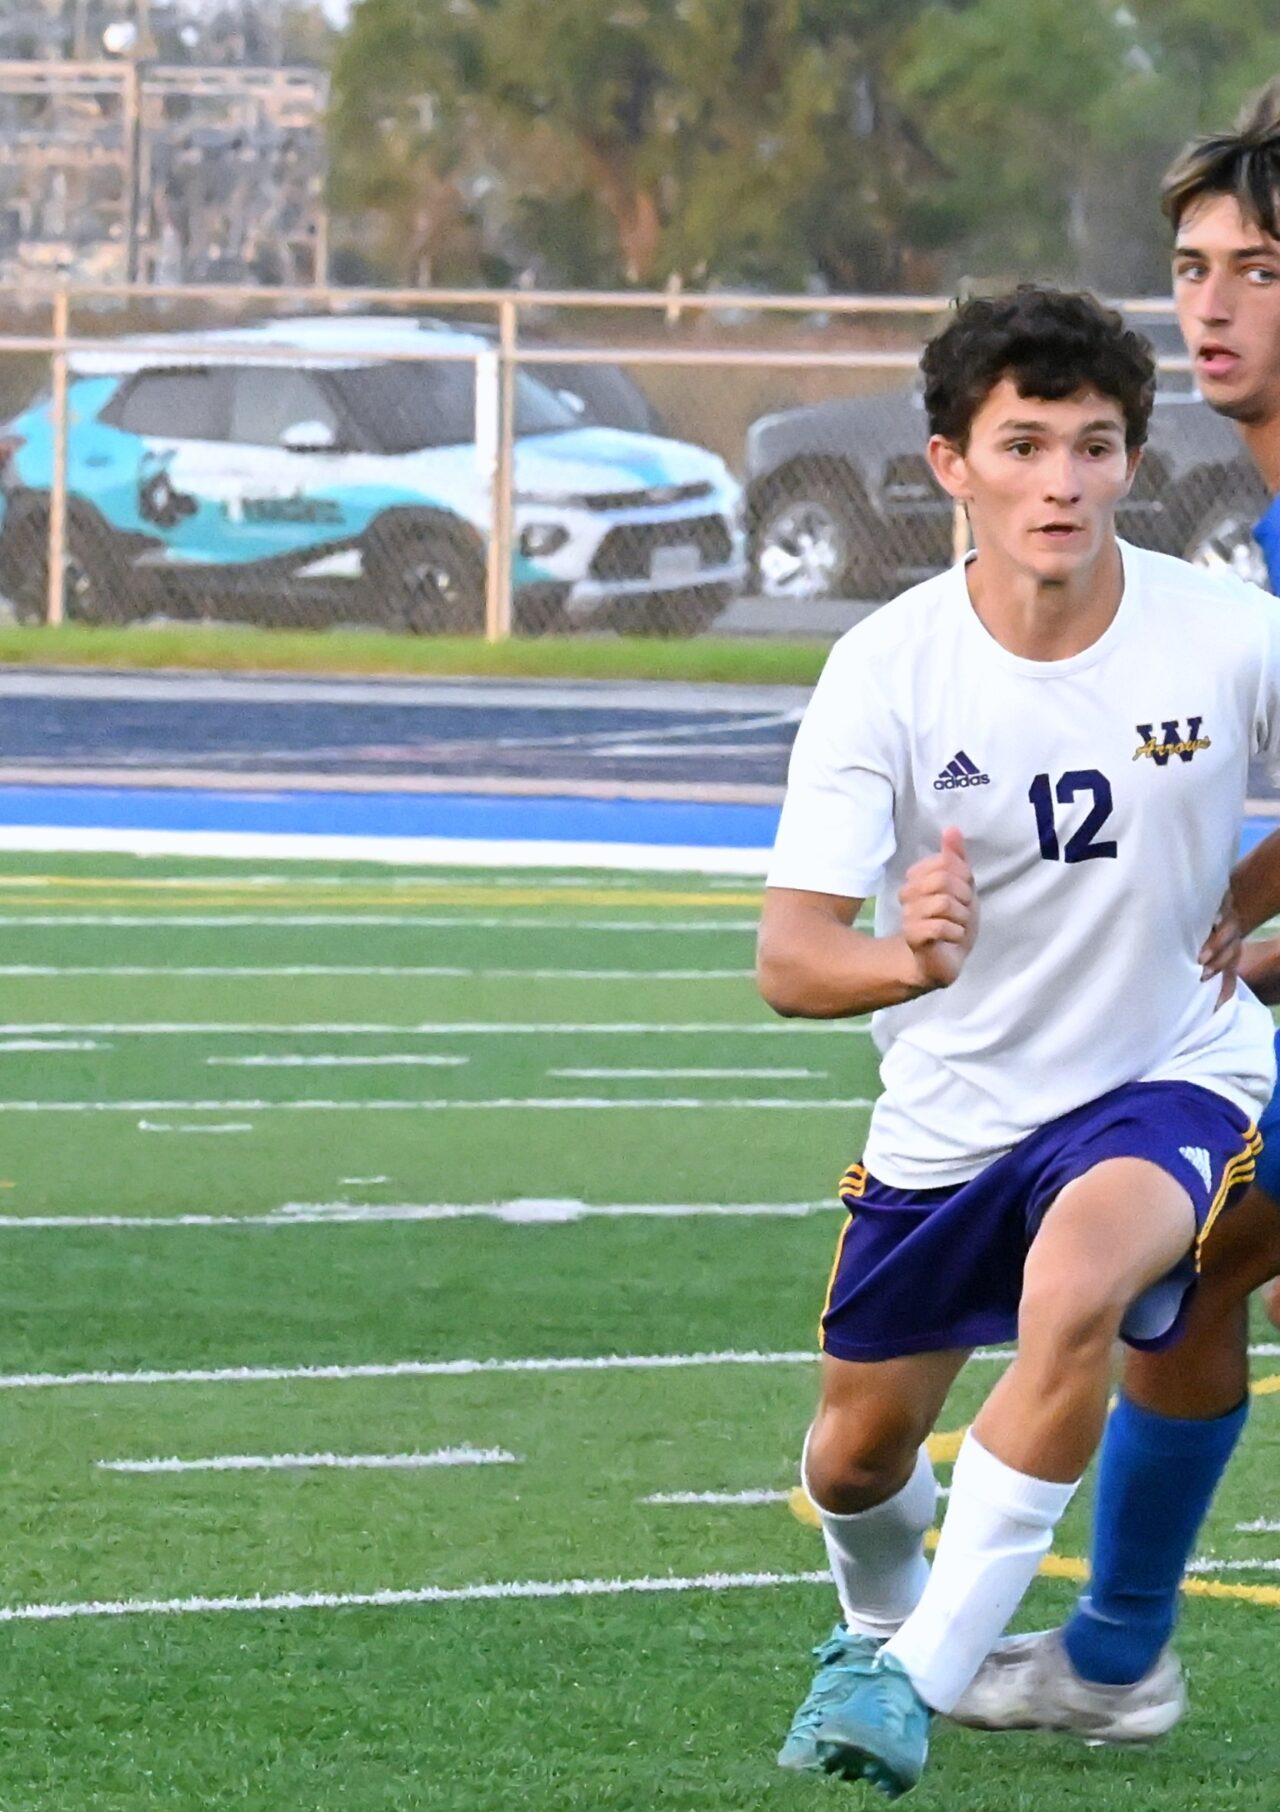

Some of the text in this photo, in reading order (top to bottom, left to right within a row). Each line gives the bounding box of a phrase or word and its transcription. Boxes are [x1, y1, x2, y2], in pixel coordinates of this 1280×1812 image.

[1136, 716, 1202, 766] W
[933, 773, 990, 790] adidas
[1028, 769, 1117, 863] 12
